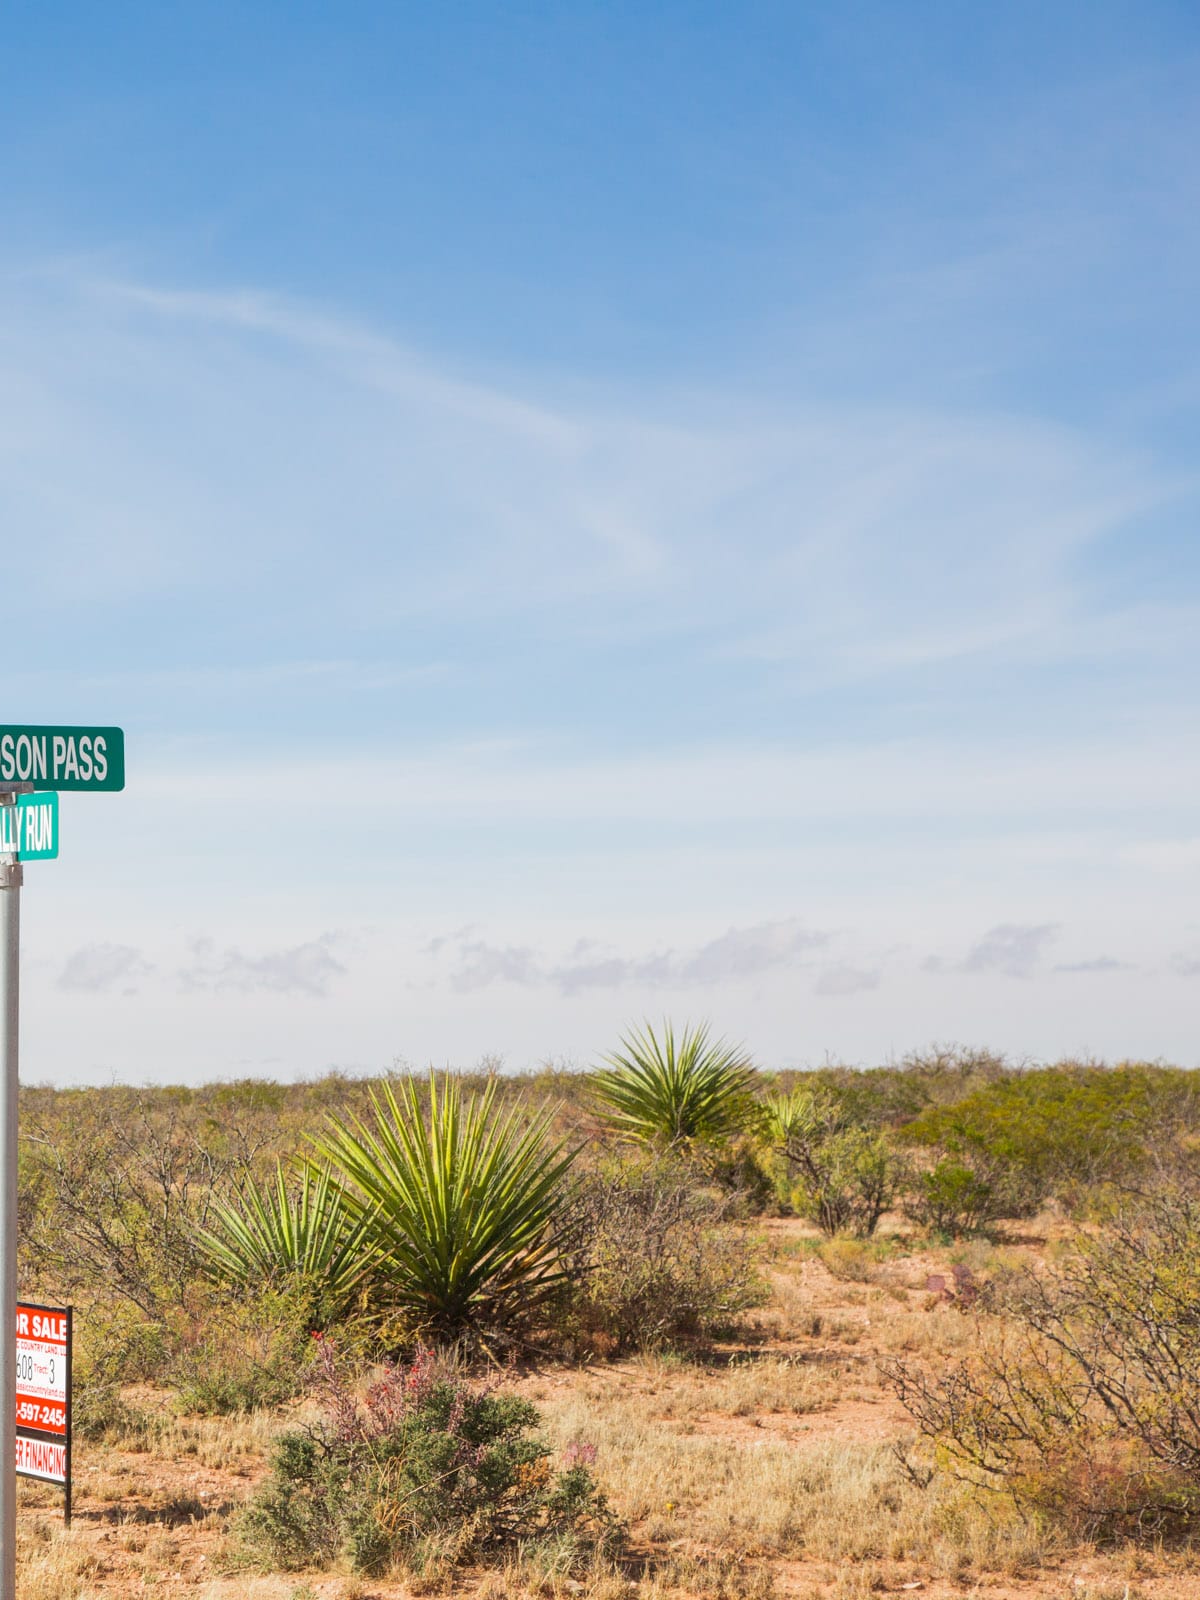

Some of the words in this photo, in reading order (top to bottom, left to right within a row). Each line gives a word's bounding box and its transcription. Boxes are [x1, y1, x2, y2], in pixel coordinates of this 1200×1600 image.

[53, 736, 108, 781] PASS
[26, 804, 52, 851] RUN
[32, 1315, 66, 1340] SALE
[49, 1358, 55, 1384] 3
